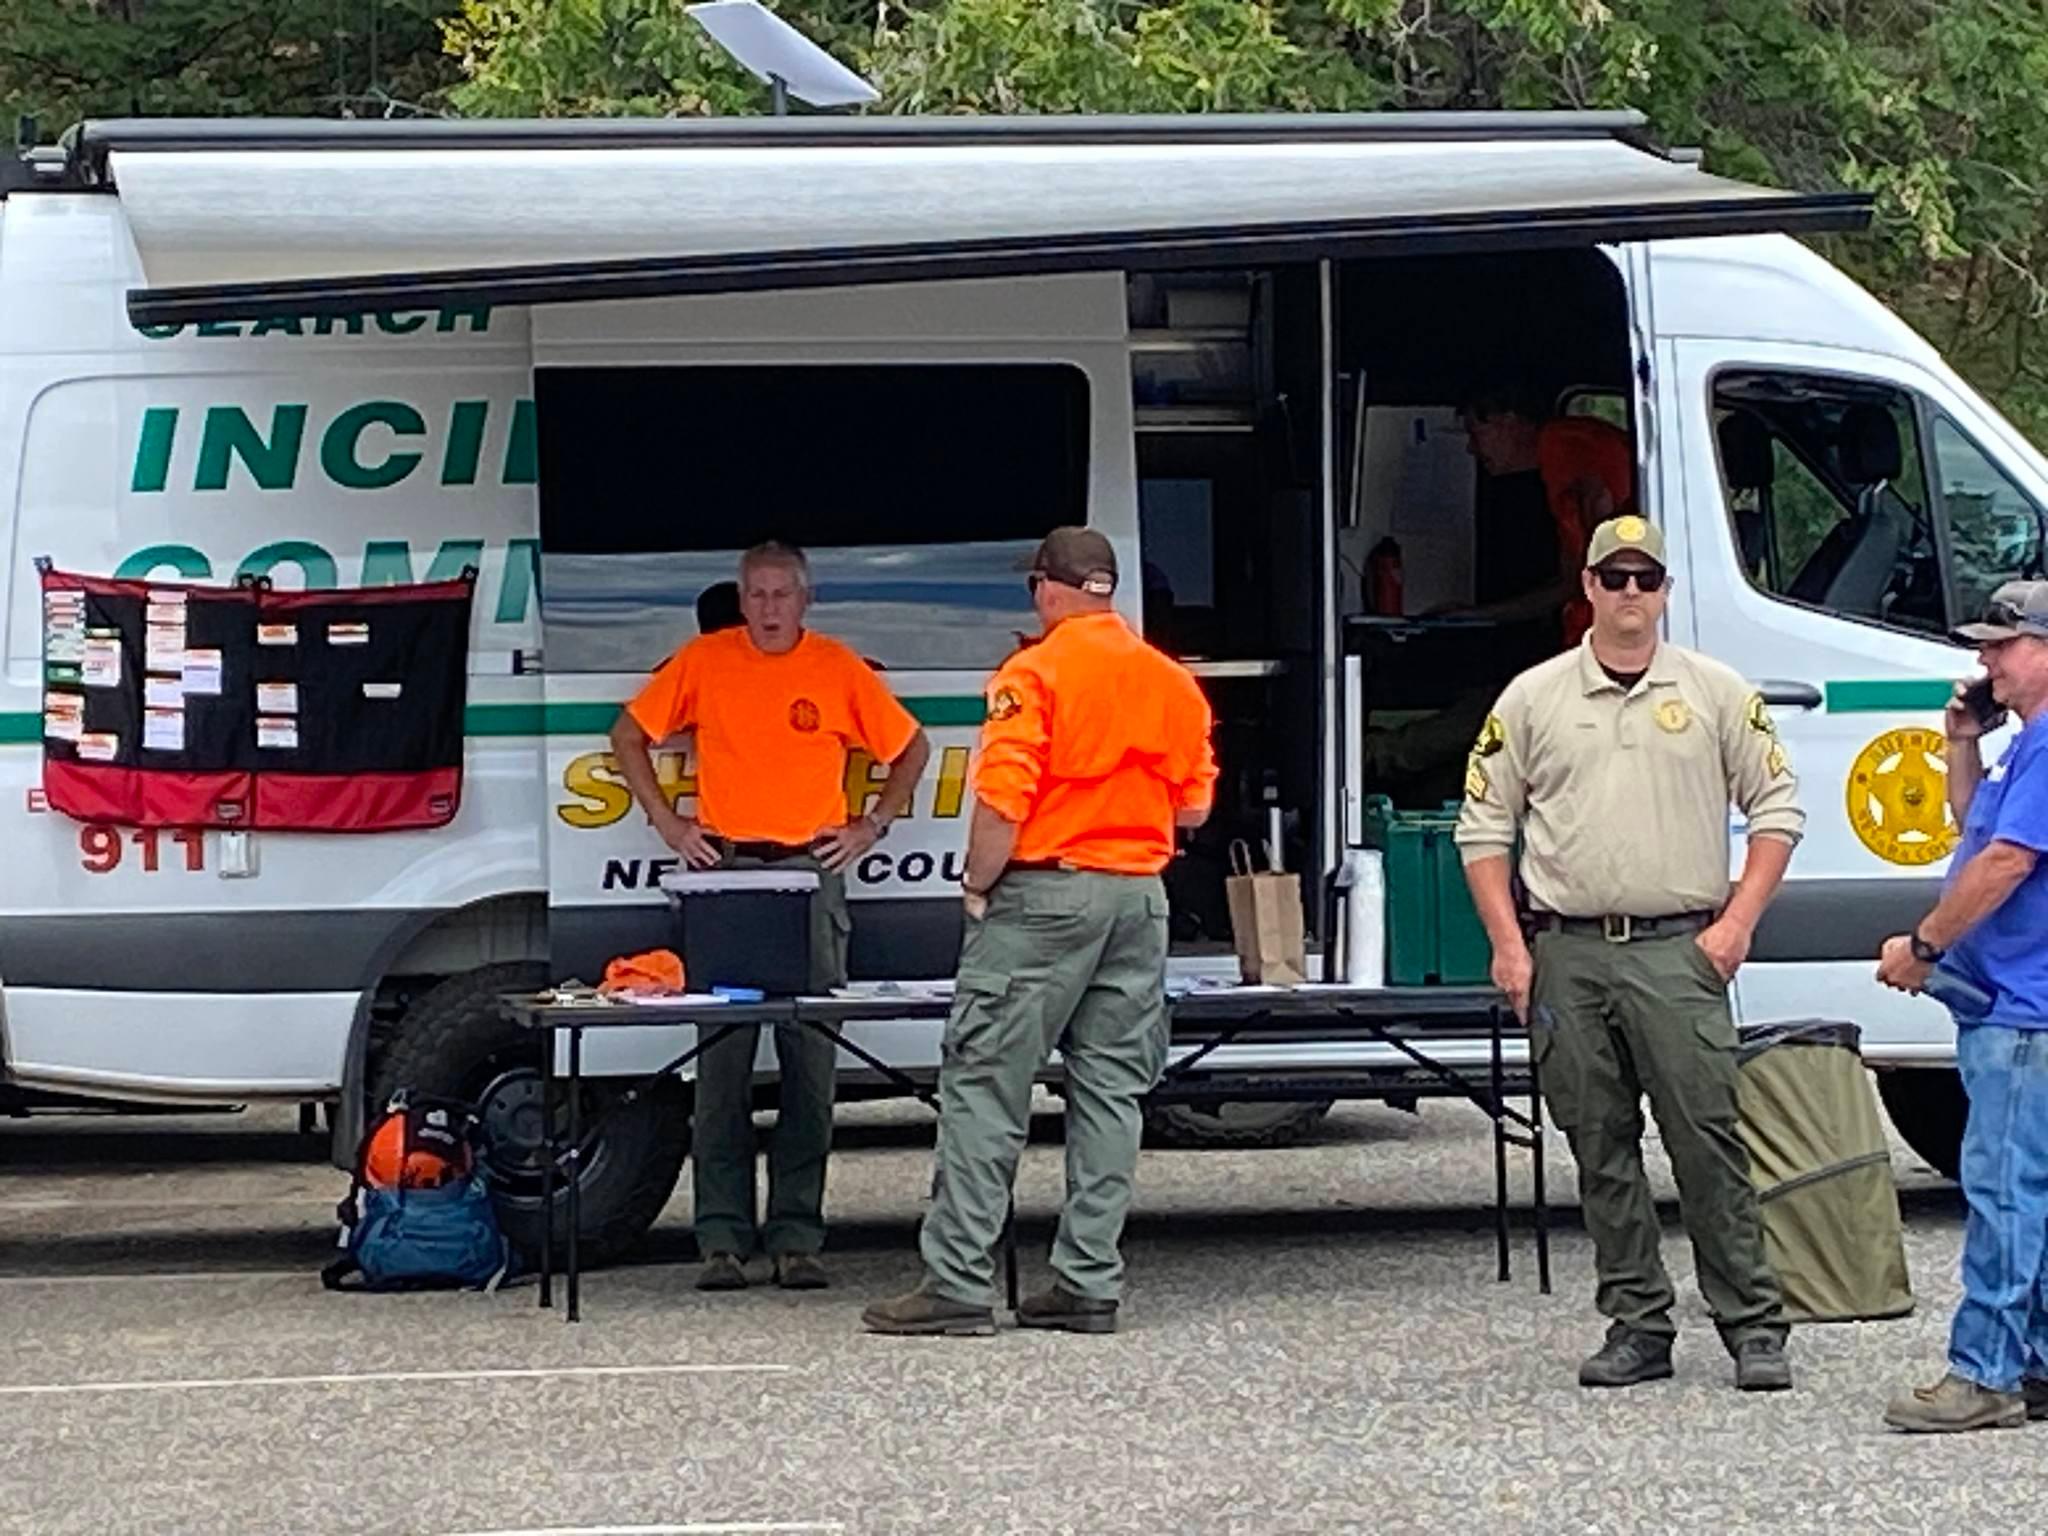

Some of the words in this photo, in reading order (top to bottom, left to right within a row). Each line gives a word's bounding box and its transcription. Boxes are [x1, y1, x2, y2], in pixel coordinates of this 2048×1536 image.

[130, 399, 540, 492] INCI
[80, 825, 204, 873] 911
[857, 851, 966, 884] COU
